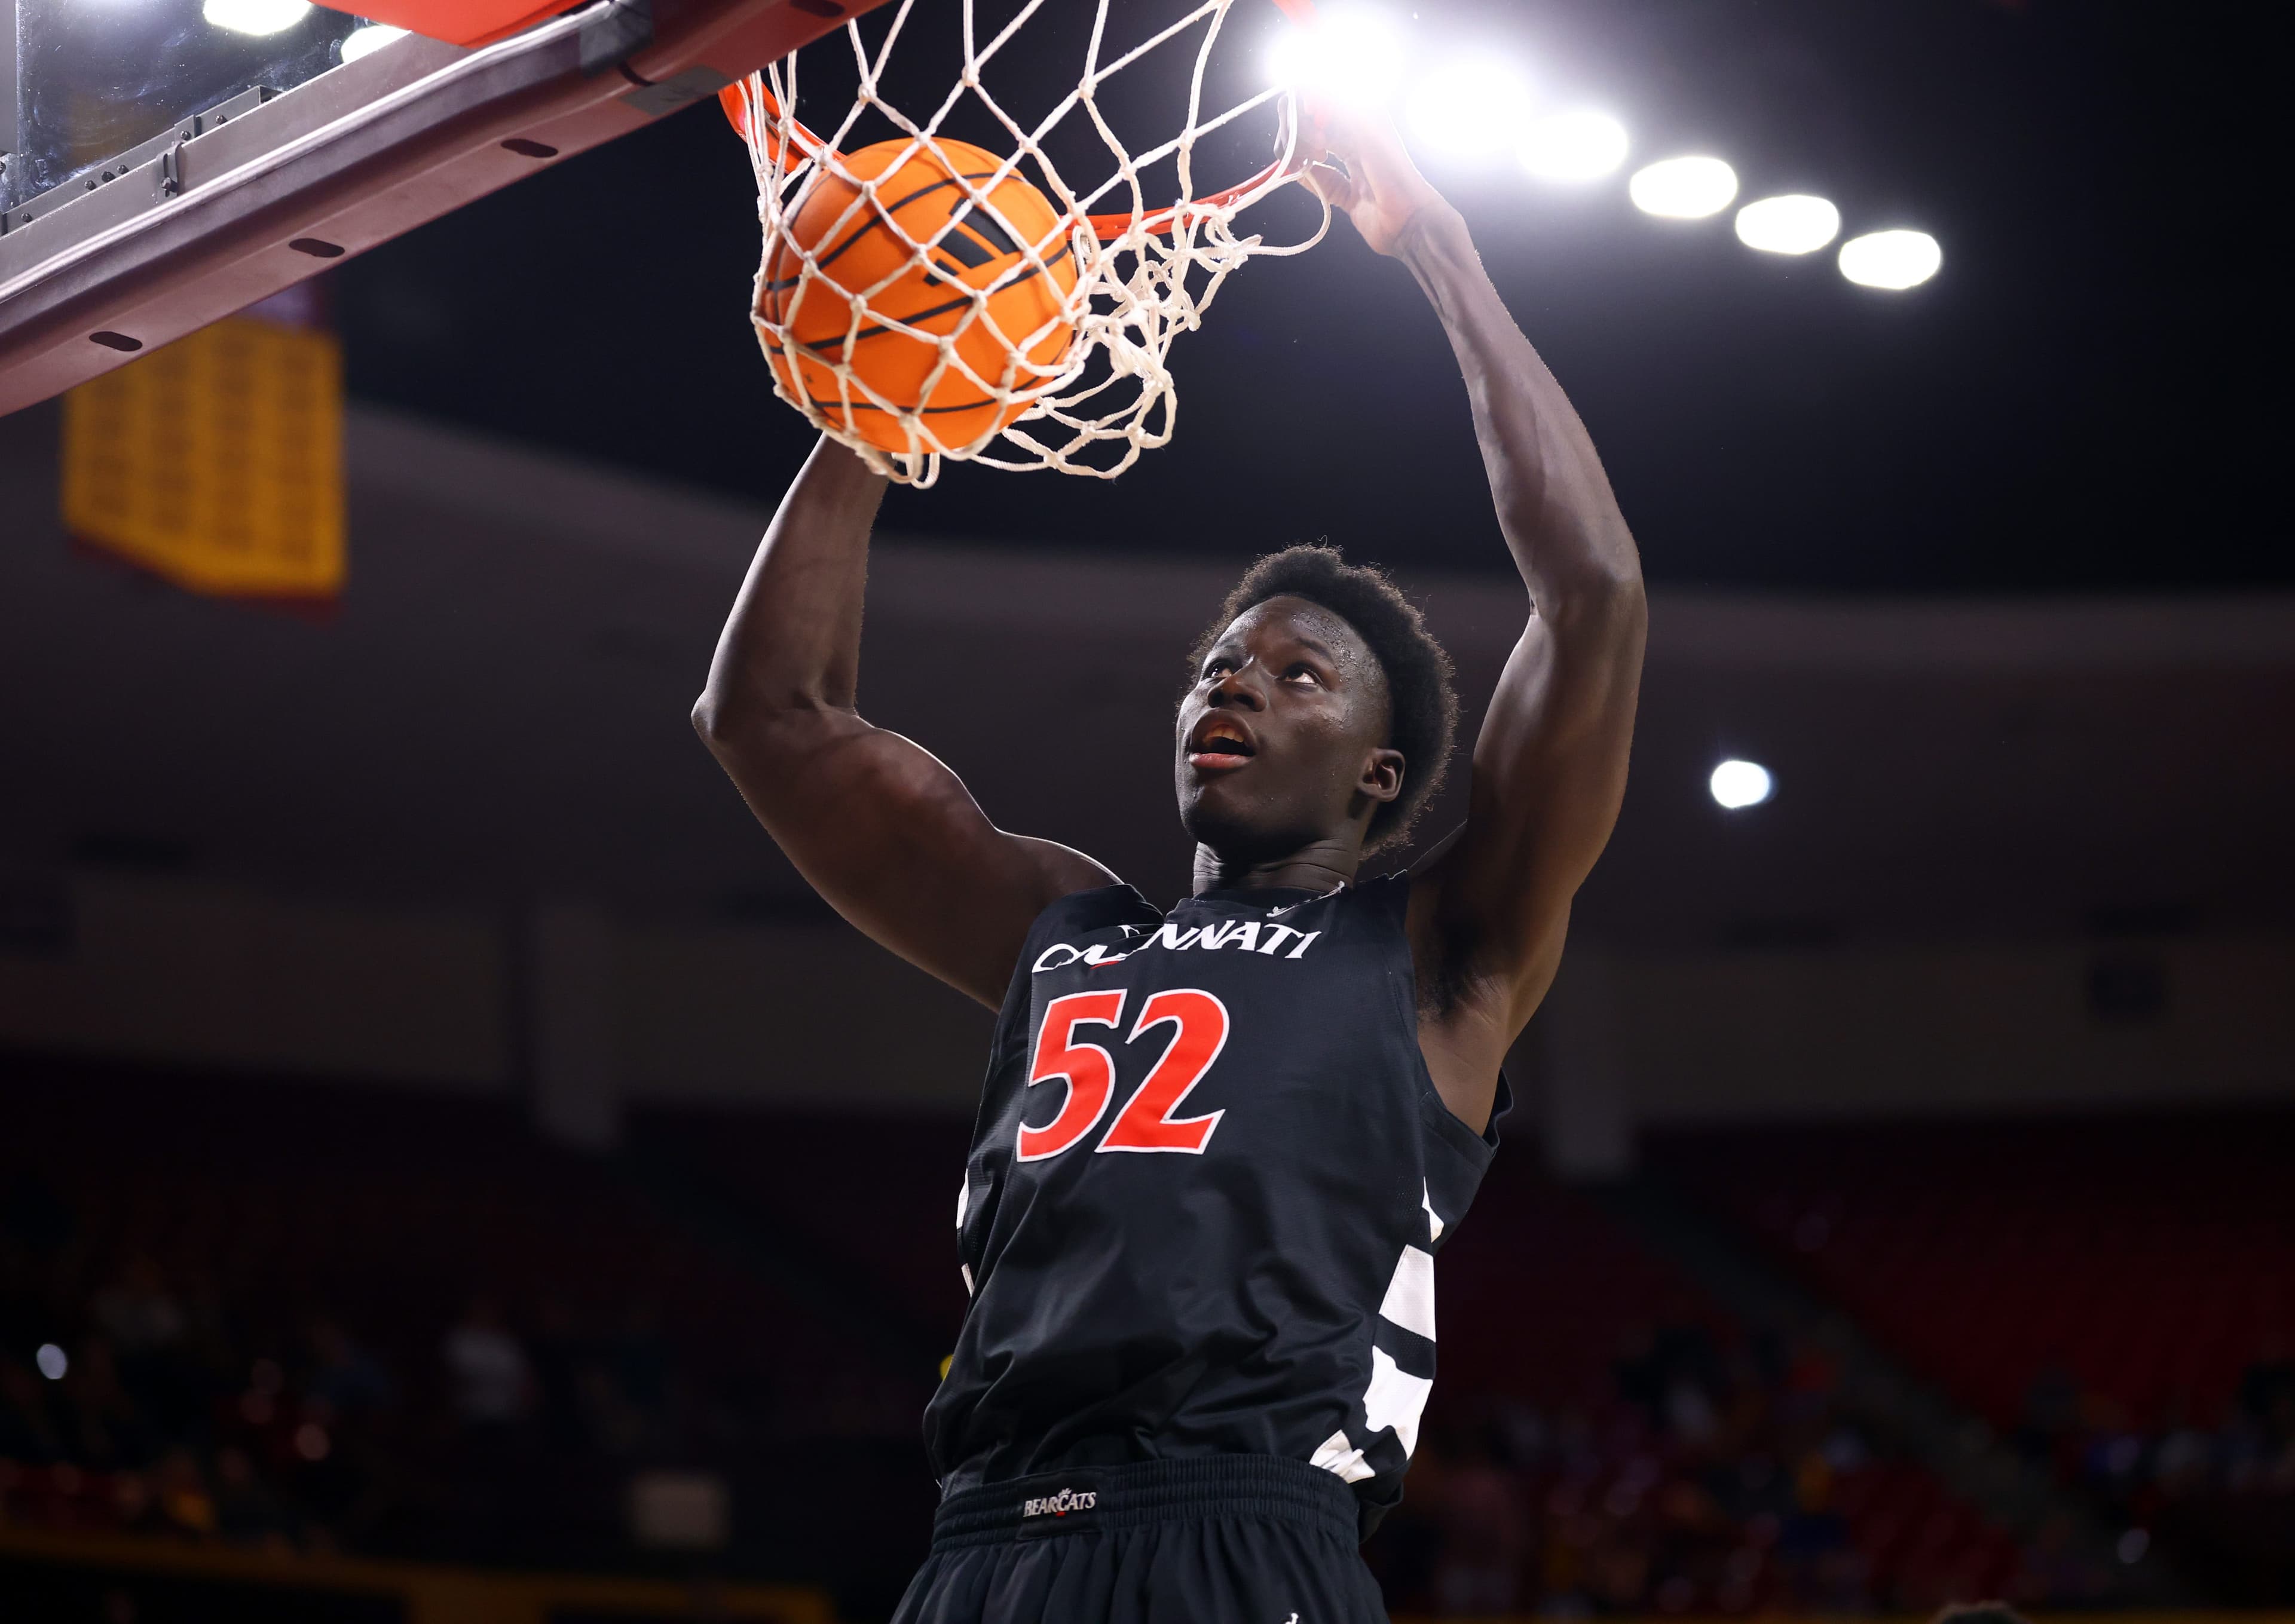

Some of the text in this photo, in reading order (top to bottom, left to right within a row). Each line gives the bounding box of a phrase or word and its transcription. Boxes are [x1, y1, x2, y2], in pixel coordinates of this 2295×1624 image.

[1032, 920, 1322, 973] CNNATI
[1017, 989, 1230, 1162] 52
[1023, 1488, 1097, 1518] BEARCATS
